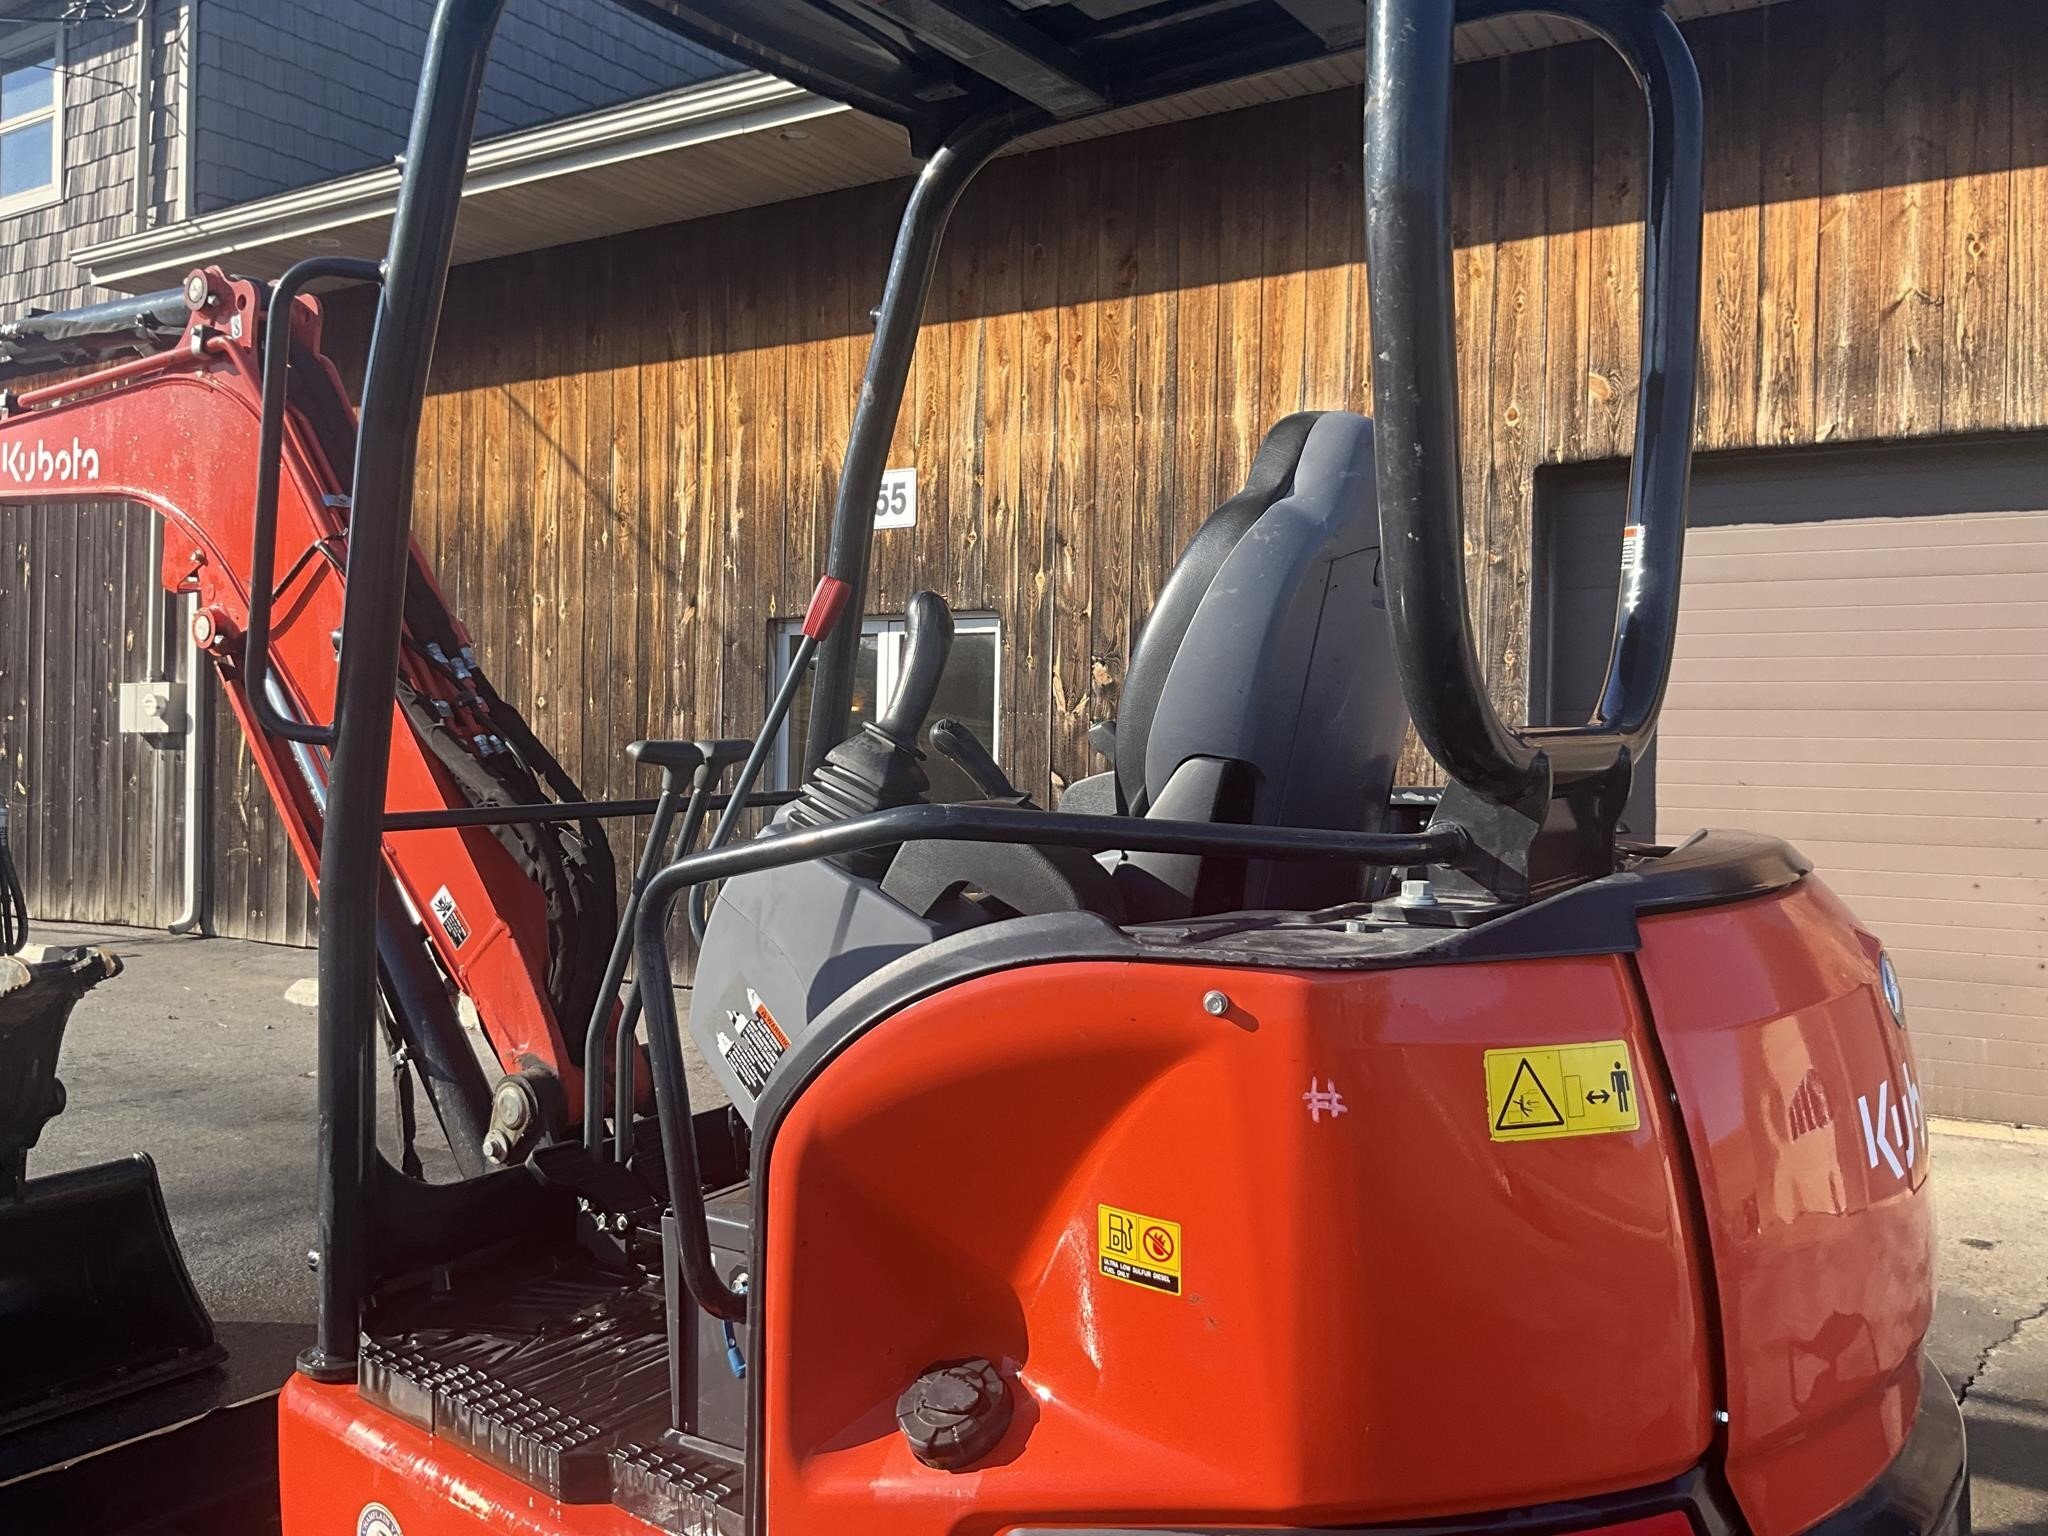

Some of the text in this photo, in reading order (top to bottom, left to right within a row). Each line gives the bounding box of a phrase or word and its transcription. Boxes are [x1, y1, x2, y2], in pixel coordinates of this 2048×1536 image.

[2, 436, 100, 482] Kubota
[1103, 1258, 1171, 1284] ULTRA LOW SULFUR DIESEL
[1103, 1265, 1130, 1279] FUEL ONLY
[362, 1511, 391, 1534] CHAMPLAIN
